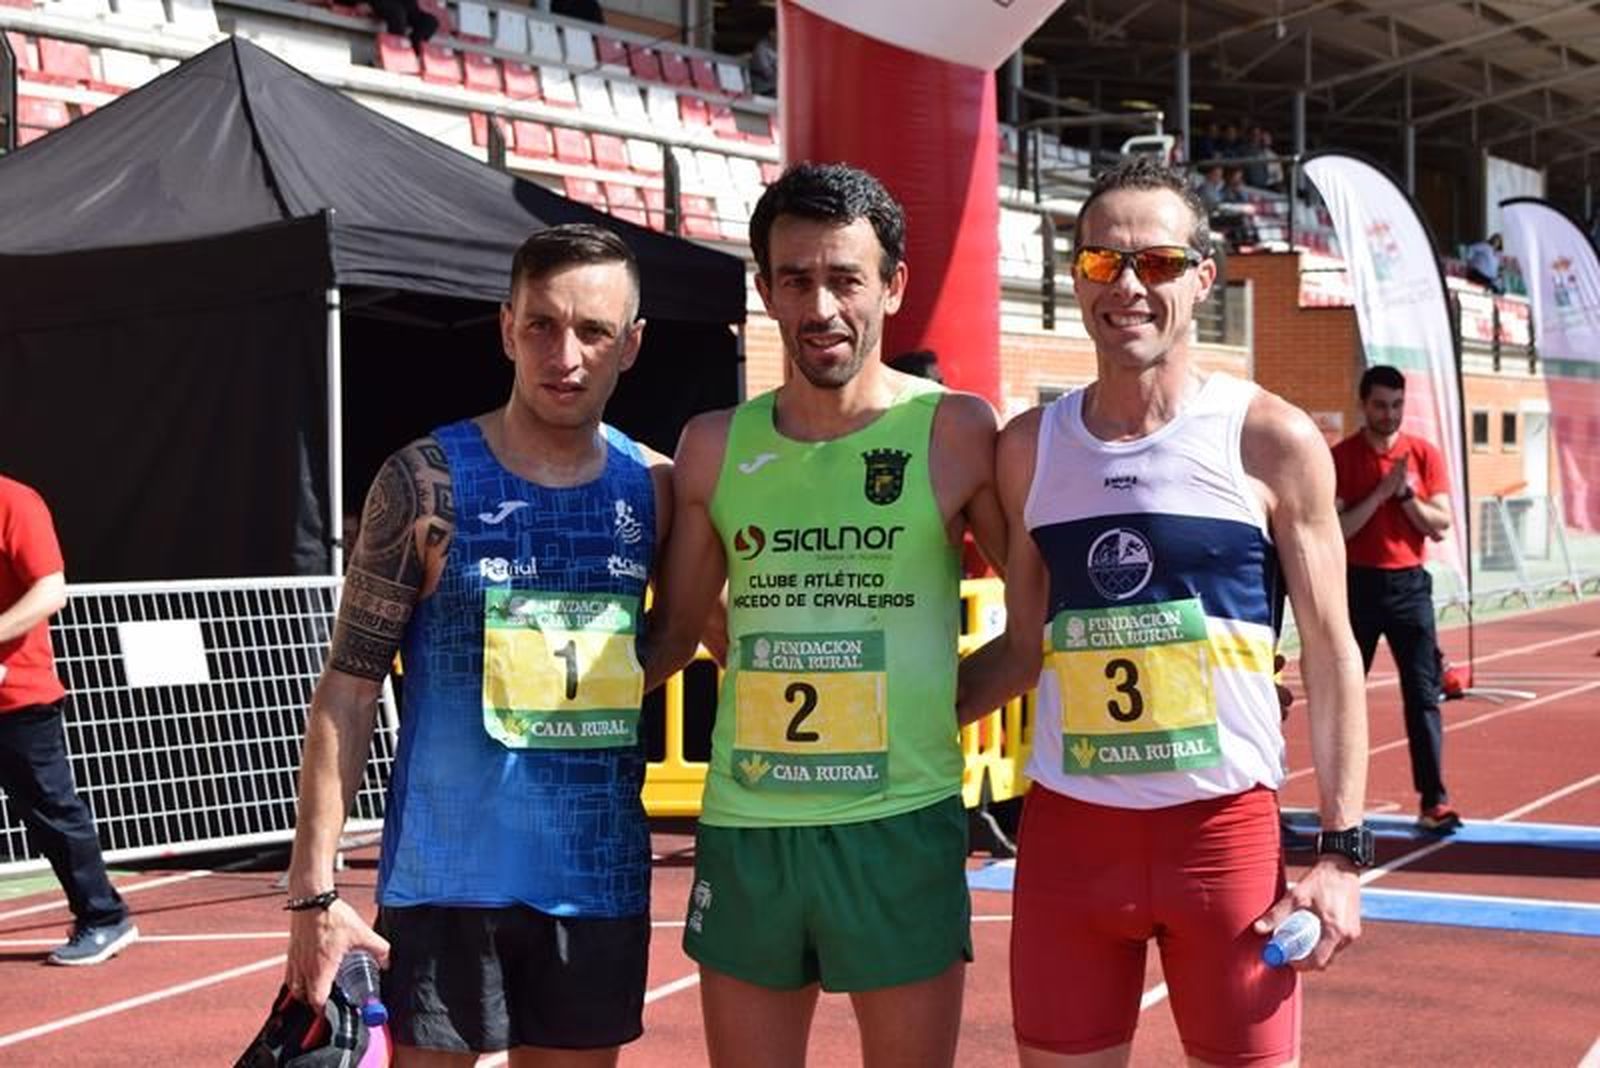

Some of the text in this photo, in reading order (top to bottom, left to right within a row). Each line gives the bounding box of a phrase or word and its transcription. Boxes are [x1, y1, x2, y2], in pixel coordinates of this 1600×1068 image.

[749, 569, 885, 588] CLUBE ATLÉTICO
[785, 594, 806, 608] DE
[813, 593, 915, 608] CAVALEIROS
[1088, 610, 1183, 631] FUNDACION
[1090, 626, 1184, 647] CAJA RURAL
[773, 640, 863, 655] FUNDACION
[554, 640, 578, 700] 1
[772, 655, 864, 670] CAJA RURAL
[1105, 658, 1144, 723] 3
[785, 682, 820, 742] 2
[531, 719, 629, 737] CAJA RURAL
[1099, 739, 1212, 763] CAJA RURAL
[772, 764, 879, 781] CAJA RURAL
